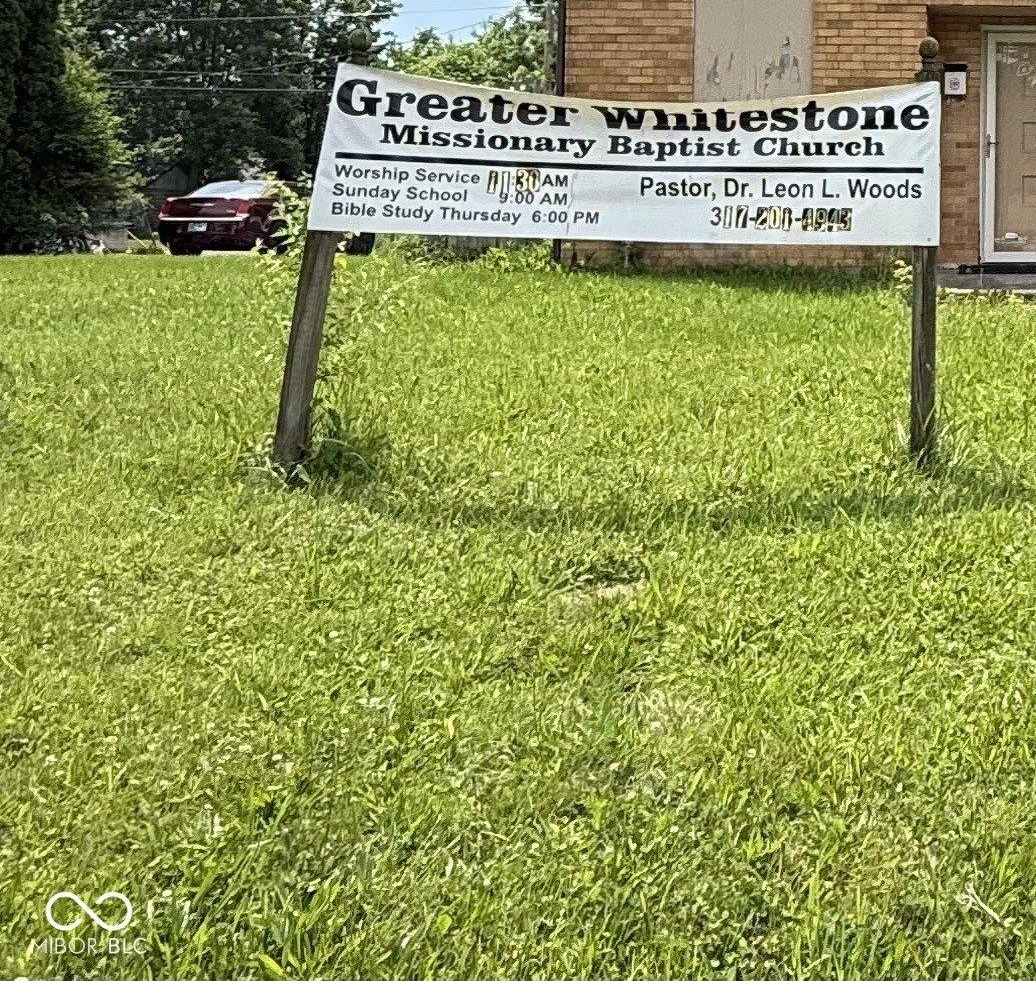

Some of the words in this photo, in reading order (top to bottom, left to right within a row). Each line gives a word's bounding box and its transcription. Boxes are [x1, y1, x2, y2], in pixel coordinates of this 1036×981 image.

[336, 78, 579, 127] Greater
[379, 123, 596, 158] Missionary
[607, 135, 741, 161] Baptist
[753, 137, 885, 157] Church
[335, 164, 409, 185] Worship
[415, 168, 480, 184] Service
[542, 174, 568, 187] AM
[332, 183, 399, 202] Sunday
[406, 186, 468, 202] School
[499, 192, 535, 205] 9:00
[540, 192, 568, 205] AM
[640, 176, 716, 201] Pastor,
[724, 178, 754, 198] Dr.
[761, 178, 814, 198] Leon
[821, 178, 840, 198] L.
[848, 178, 922, 199] Woods
[331, 202, 377, 217] Bible
[381, 205, 433, 223] Study
[441, 207, 521, 225] Thursday
[532, 210, 568, 224] 6:00
[573, 211, 600, 224] PM
